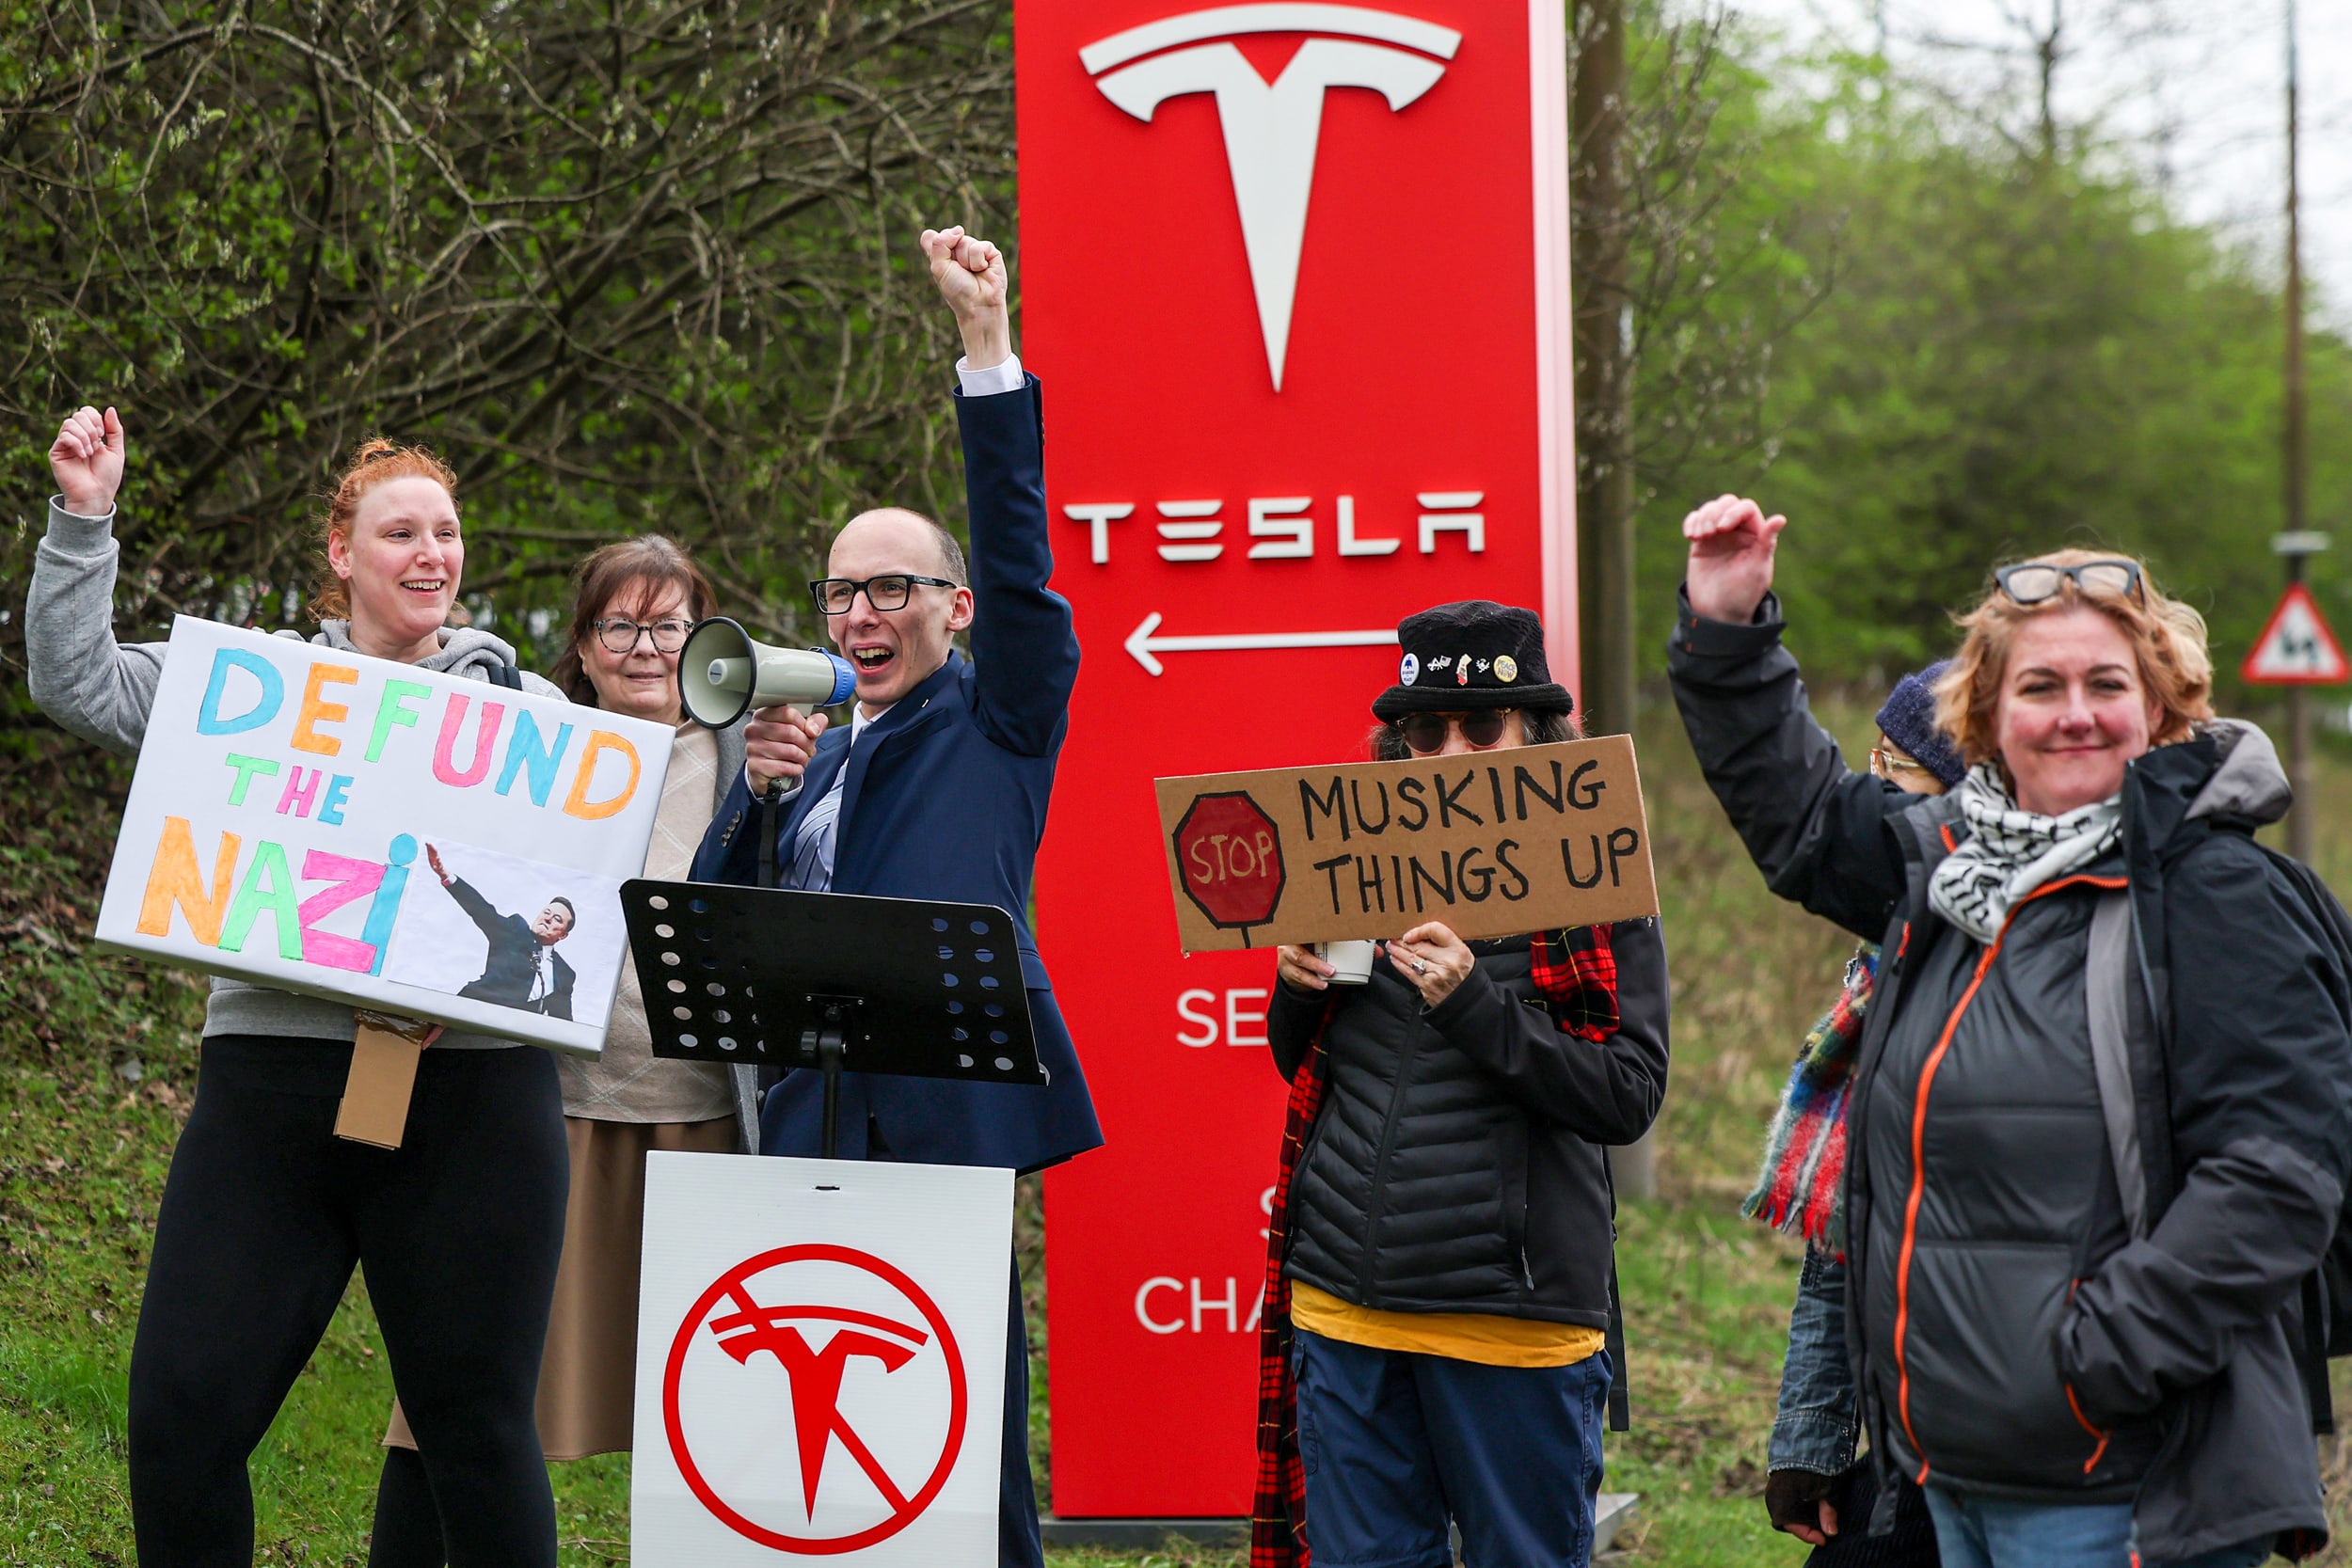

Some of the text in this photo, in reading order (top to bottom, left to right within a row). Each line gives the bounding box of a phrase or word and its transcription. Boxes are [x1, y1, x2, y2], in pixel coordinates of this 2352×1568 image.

[1063, 491, 1486, 563] TESLA
[197, 648, 642, 820] DEFUND
[225, 752, 355, 825] THE
[1298, 759, 1607, 842] MUSKING
[1190, 831, 1273, 884] STOP
[1313, 827, 1639, 915] THINGS UP
